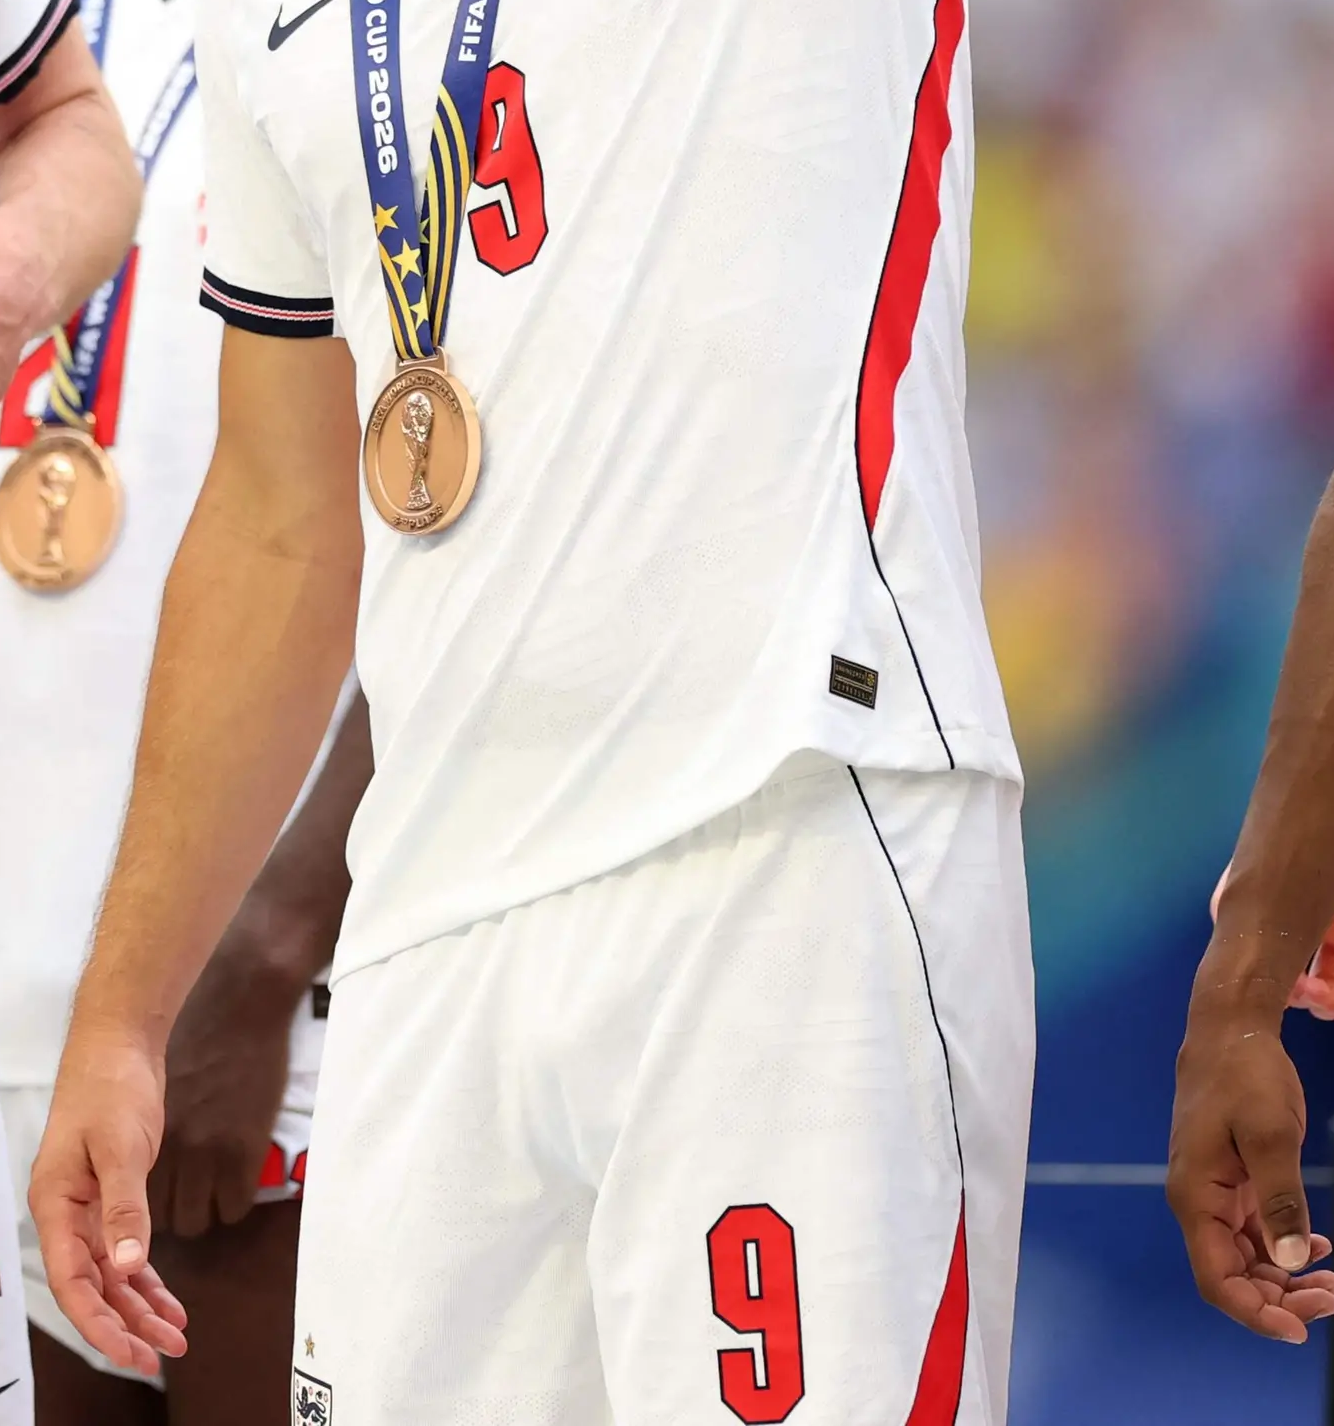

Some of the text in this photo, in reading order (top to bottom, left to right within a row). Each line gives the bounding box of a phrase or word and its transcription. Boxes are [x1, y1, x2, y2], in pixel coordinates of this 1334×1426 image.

[365, 8, 388, 65] CUP
[367, 67, 398, 175] 2026
[468, 60, 549, 277] 9
[705, 1201, 805, 1425] 9
